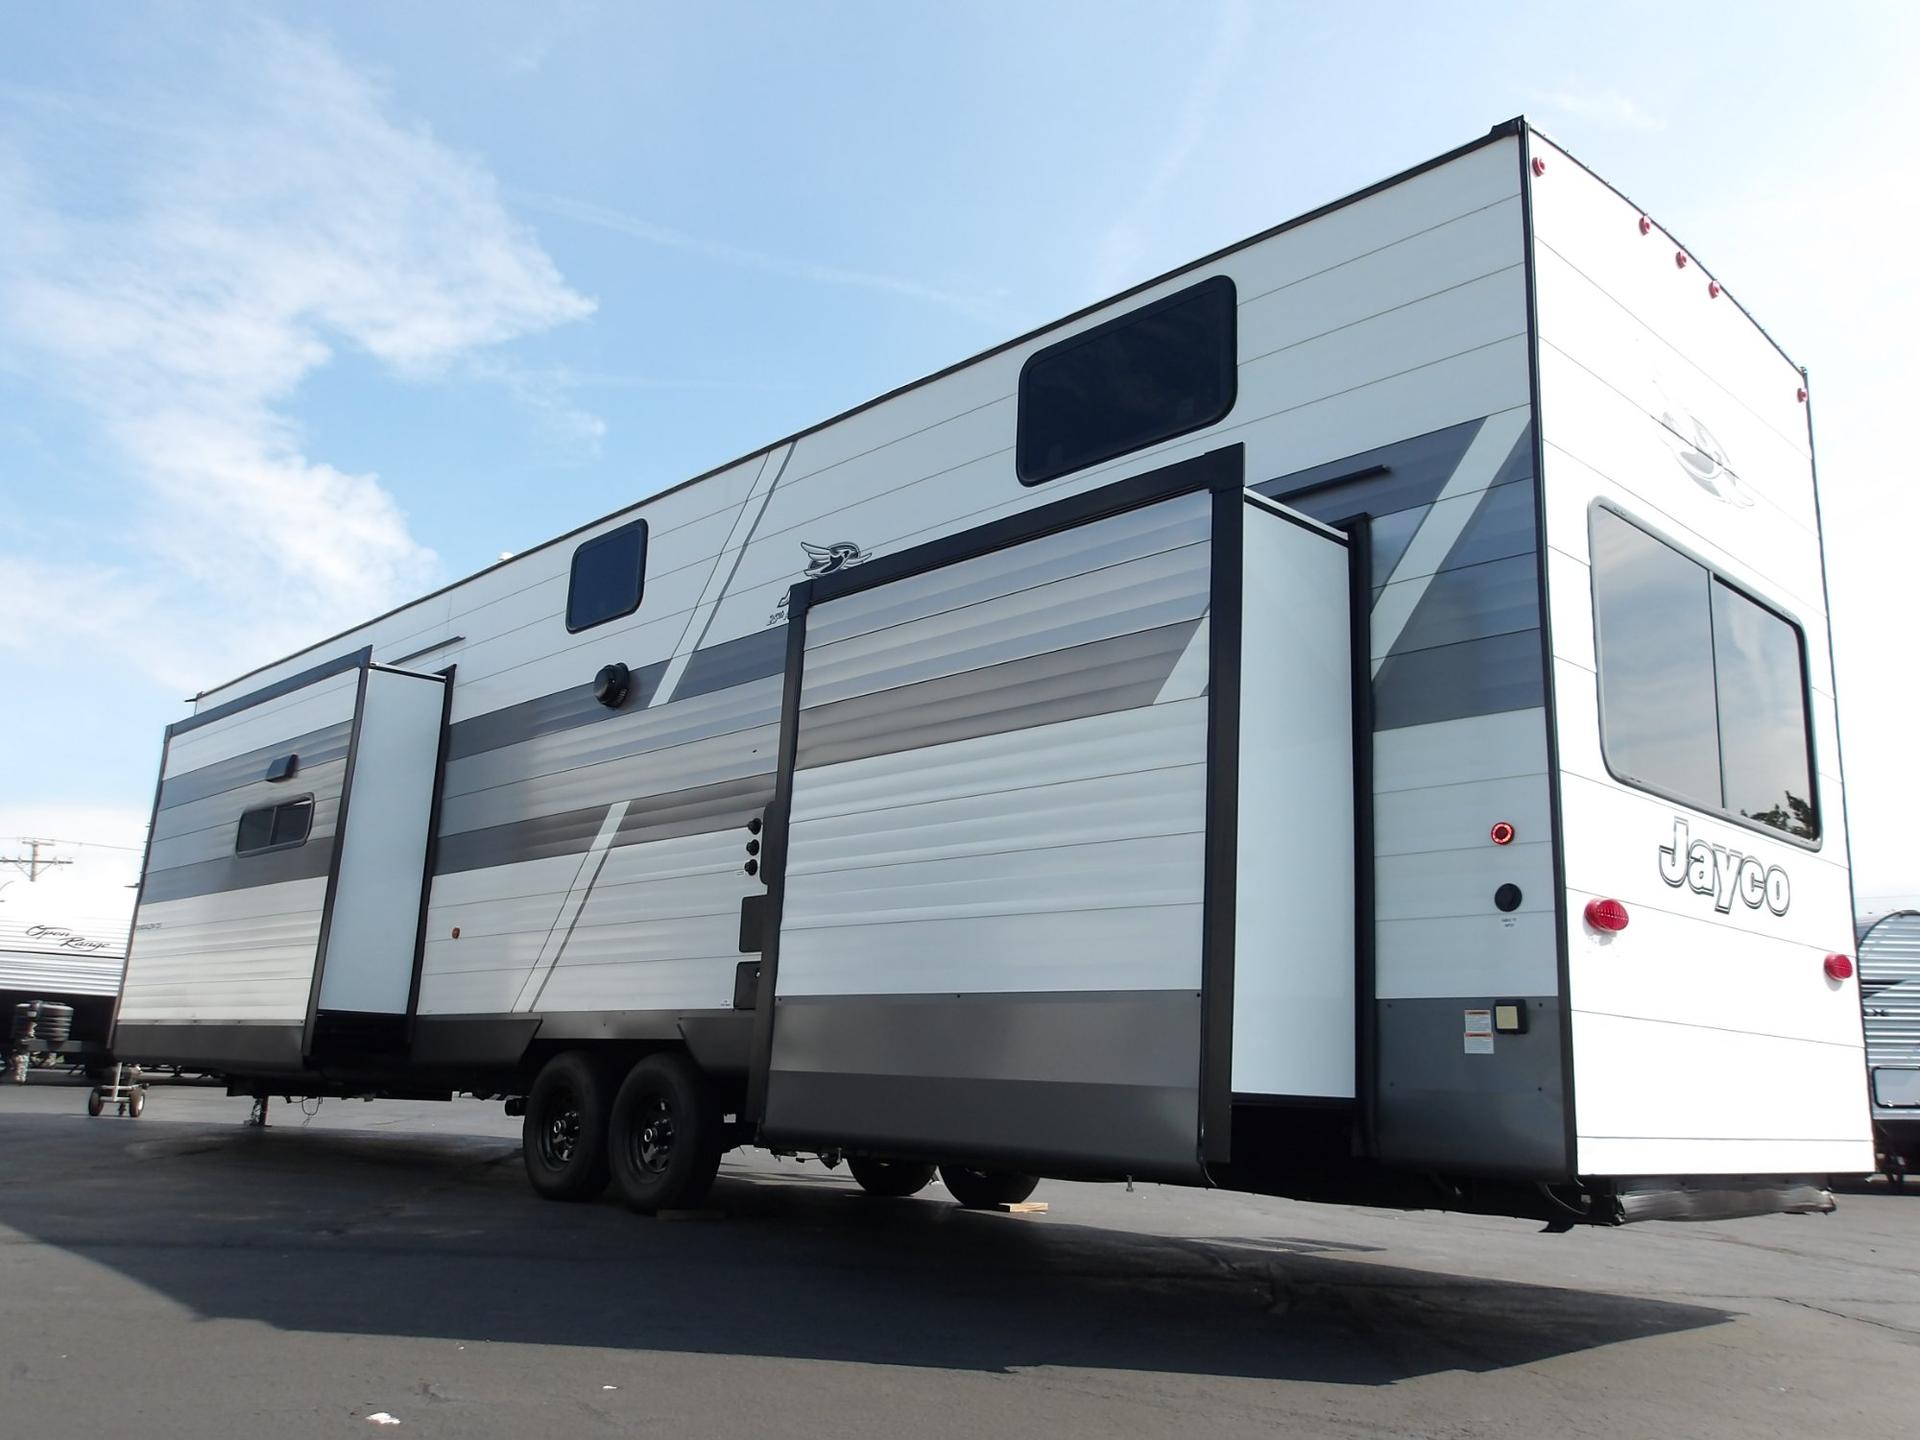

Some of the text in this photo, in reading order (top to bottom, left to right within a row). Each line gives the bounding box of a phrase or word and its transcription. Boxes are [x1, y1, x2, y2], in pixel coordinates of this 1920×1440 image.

[1659, 816, 1790, 917] Jayco
[25, 925, 72, 939] Open
[58, 937, 110, 952] Range
